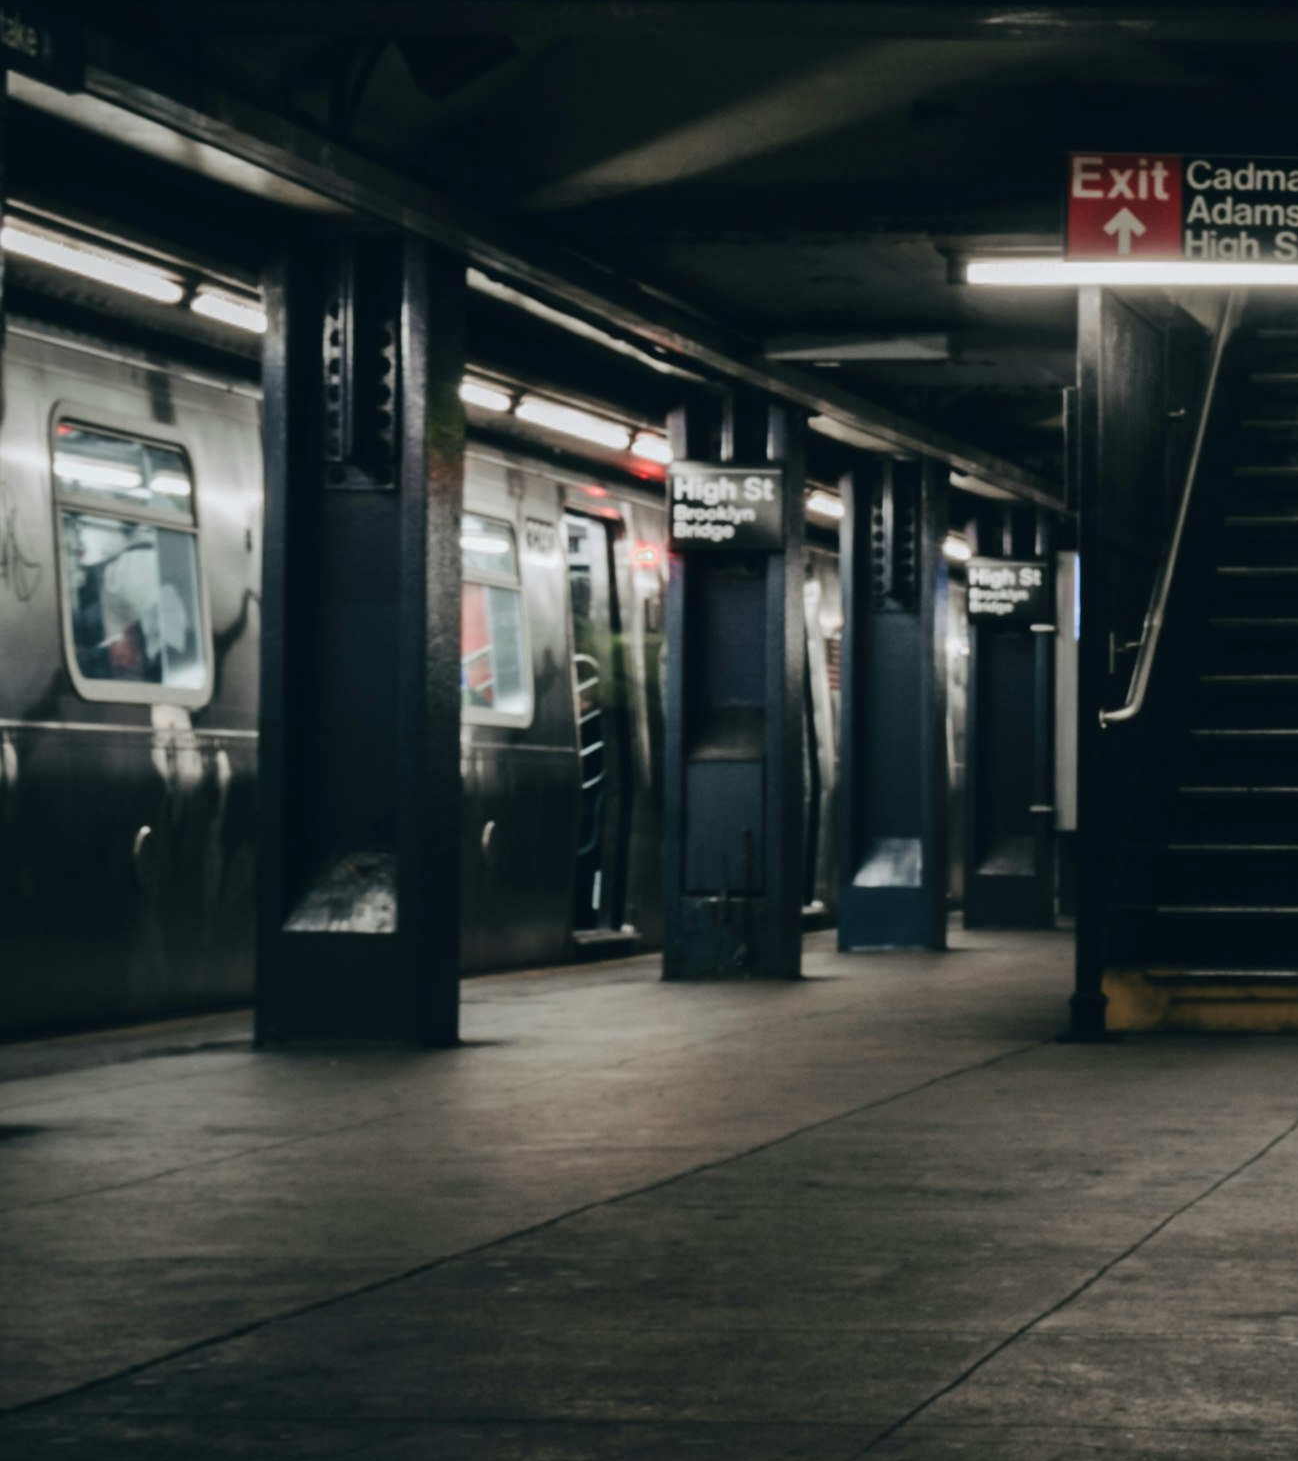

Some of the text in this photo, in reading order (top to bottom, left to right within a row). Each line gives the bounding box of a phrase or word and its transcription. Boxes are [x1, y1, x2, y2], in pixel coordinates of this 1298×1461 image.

[1072, 157, 1169, 201] Exit
[1185, 230, 1260, 261] High
[673, 476, 775, 506] High St
[673, 504, 756, 525] Brooklyn
[673, 521, 735, 542] Bridge
[969, 568, 1016, 590] High
